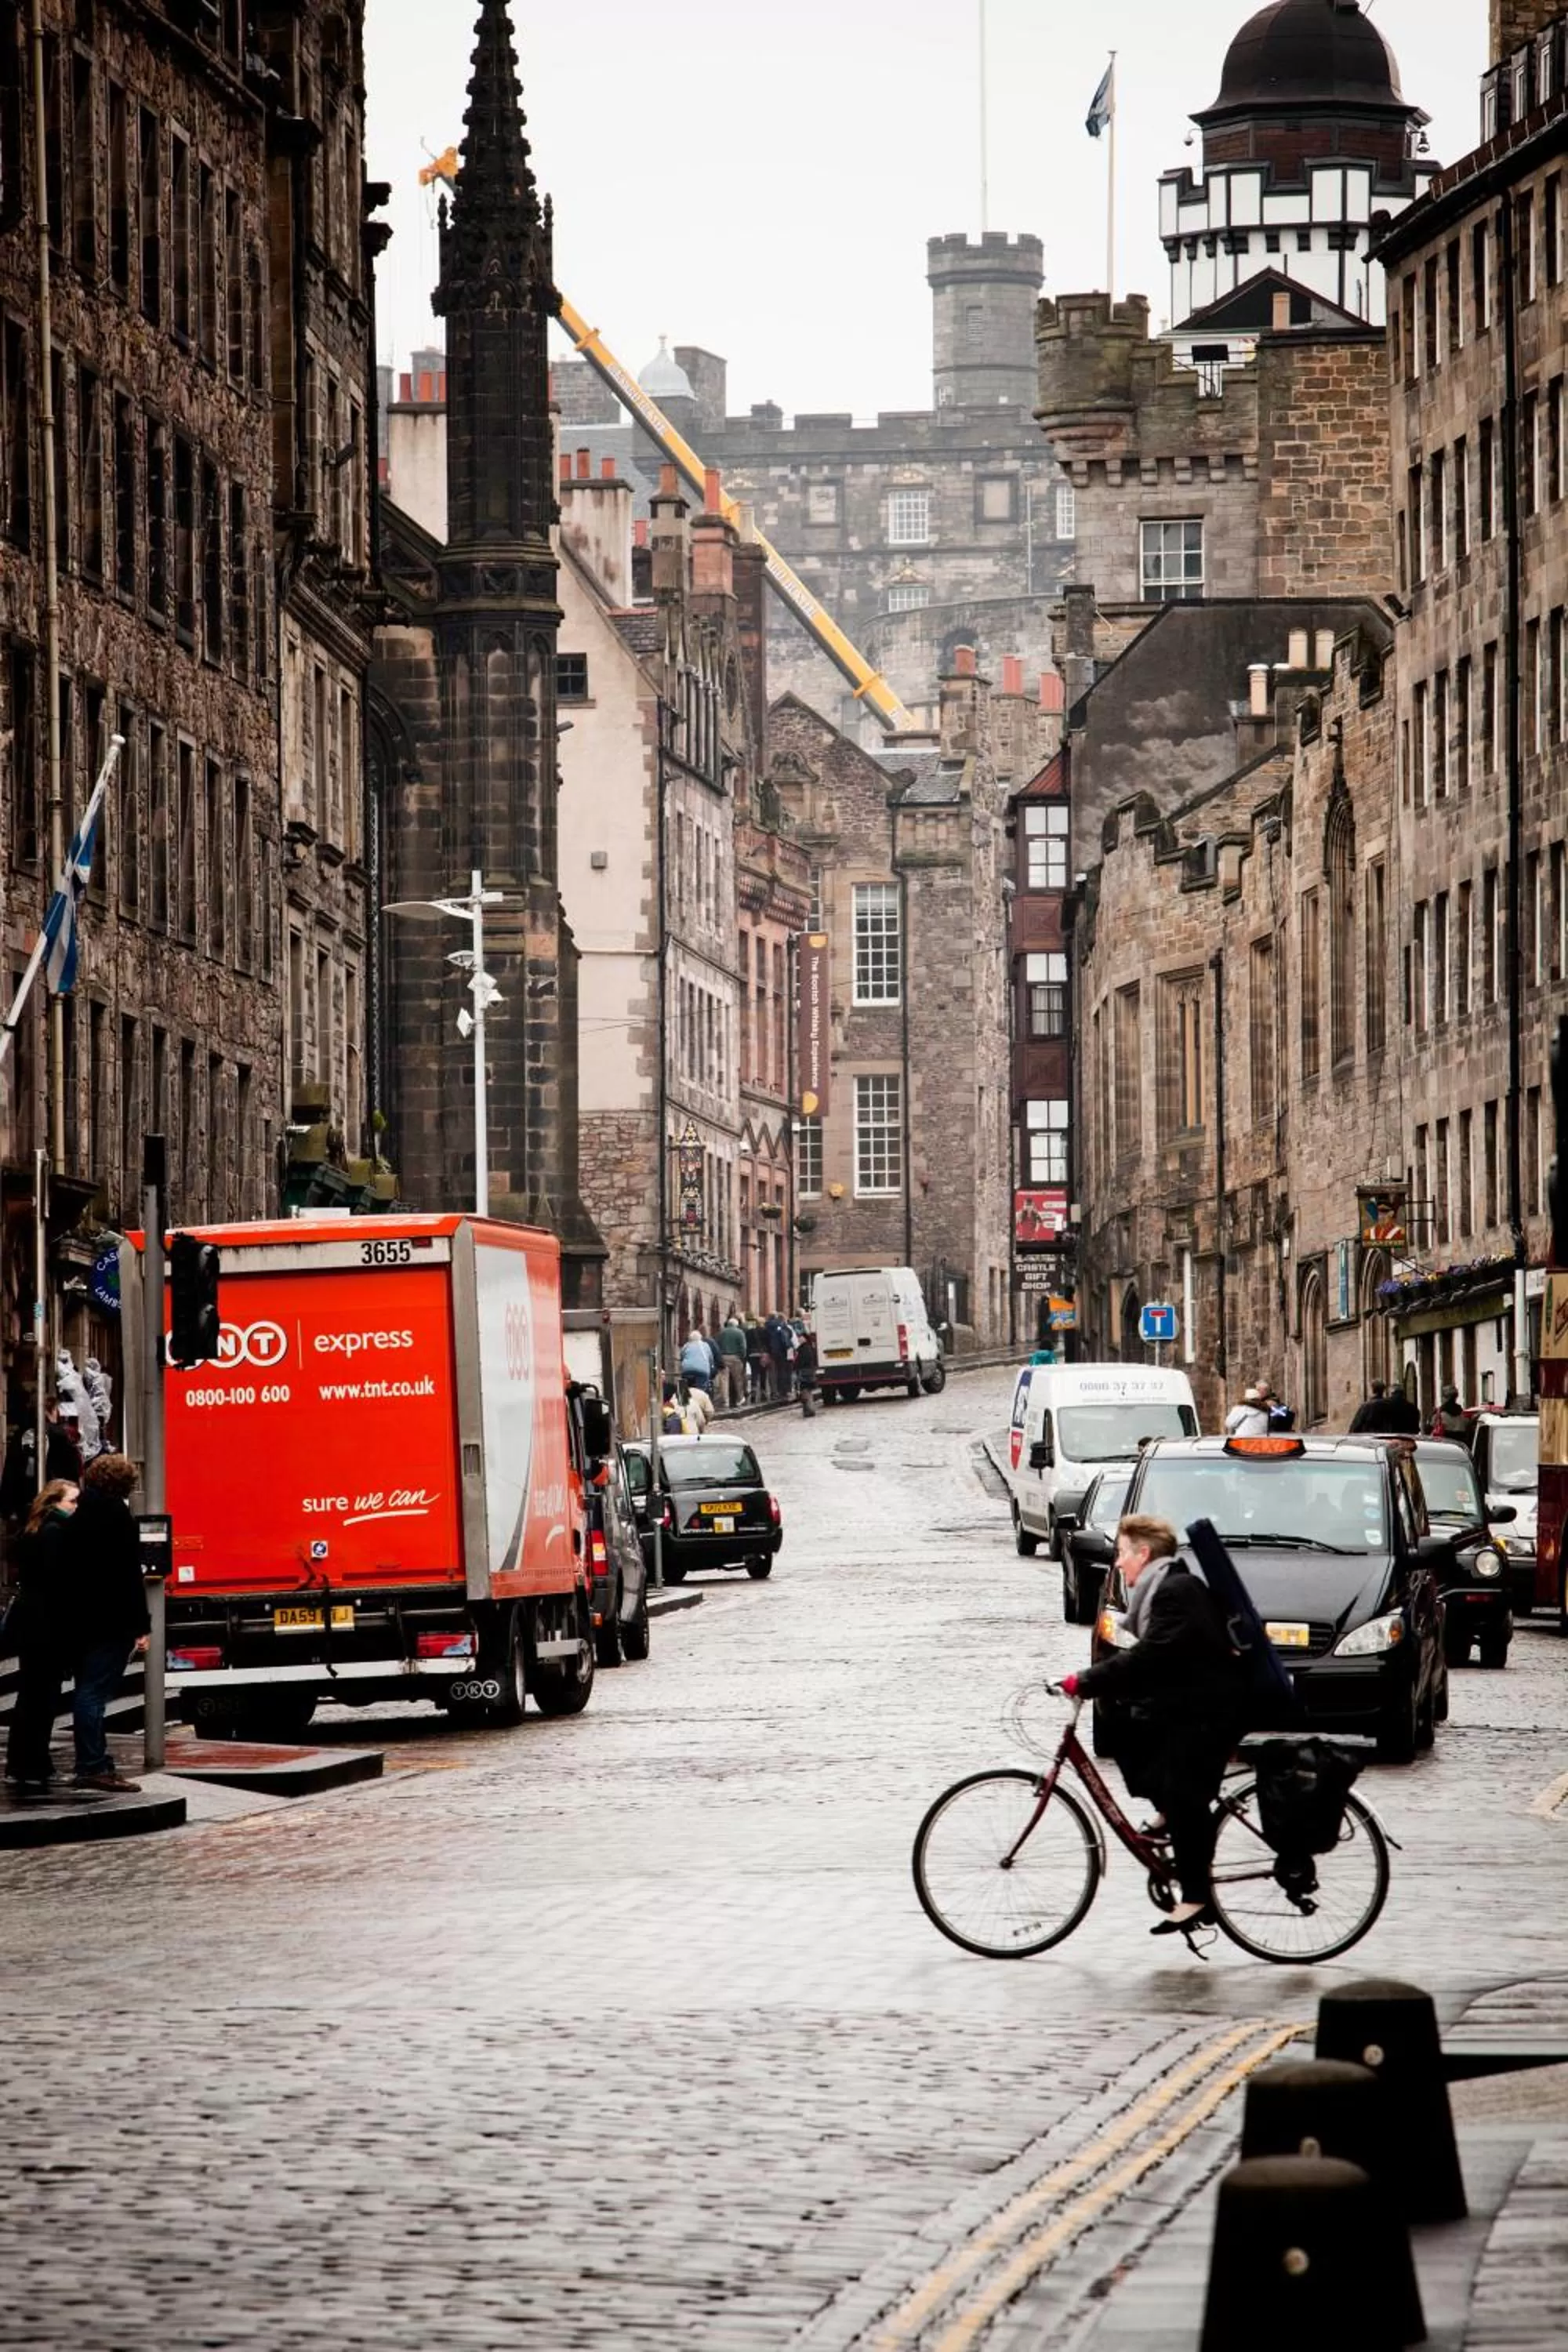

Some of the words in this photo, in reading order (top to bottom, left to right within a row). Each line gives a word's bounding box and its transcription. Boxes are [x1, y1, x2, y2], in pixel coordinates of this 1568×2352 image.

[810, 1006, 819, 1039] Whisky
[811, 1040, 820, 1088] Experience
[361, 1241, 411, 1264] 3655
[1016, 1263, 1056, 1272] CASTLE
[1025, 1272, 1047, 1281] GIFT
[314, 1330, 414, 1359] express
[185, 1385, 256, 1407] 0800-100
[260, 1385, 290, 1403] 600
[319, 1375, 435, 1400] www.tnt.co.uk
[302, 1496, 349, 1512] sure
[354, 1491, 384, 1510] we
[388, 1488, 441, 1506] can
[278, 1609, 316, 1624] DA59
